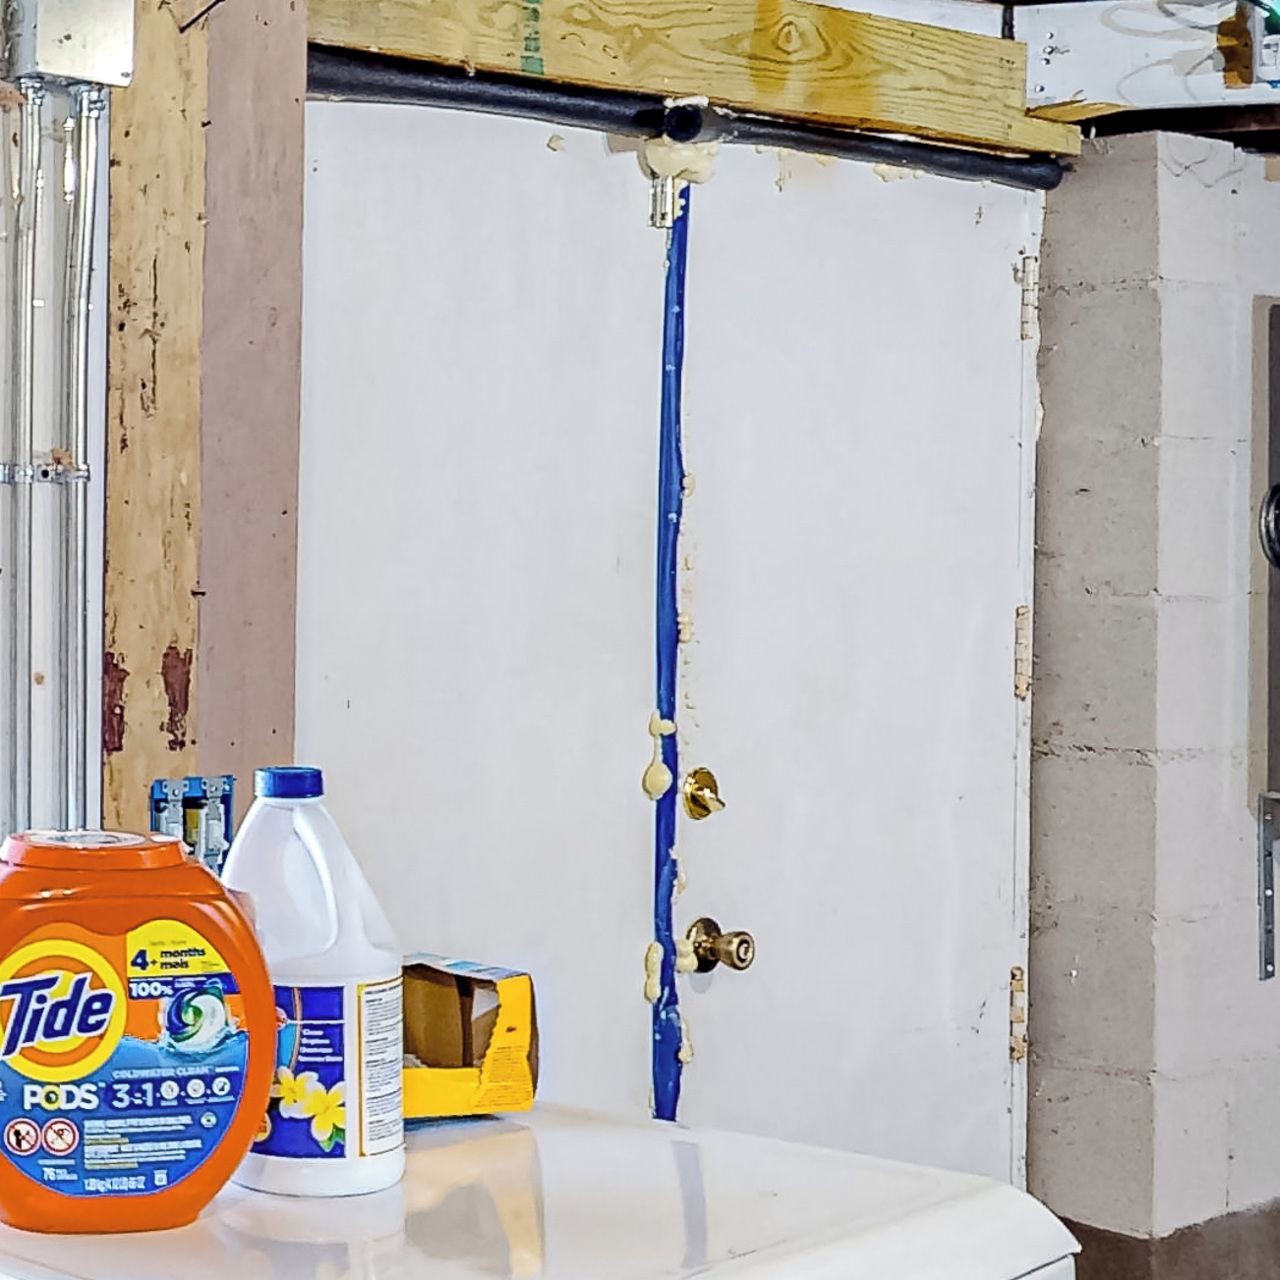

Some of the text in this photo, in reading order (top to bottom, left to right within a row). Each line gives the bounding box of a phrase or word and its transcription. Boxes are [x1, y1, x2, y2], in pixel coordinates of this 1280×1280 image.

[160, 947, 206, 959] months
[128, 981, 174, 998] 100%
[23, 1083, 100, 1110] PODS
